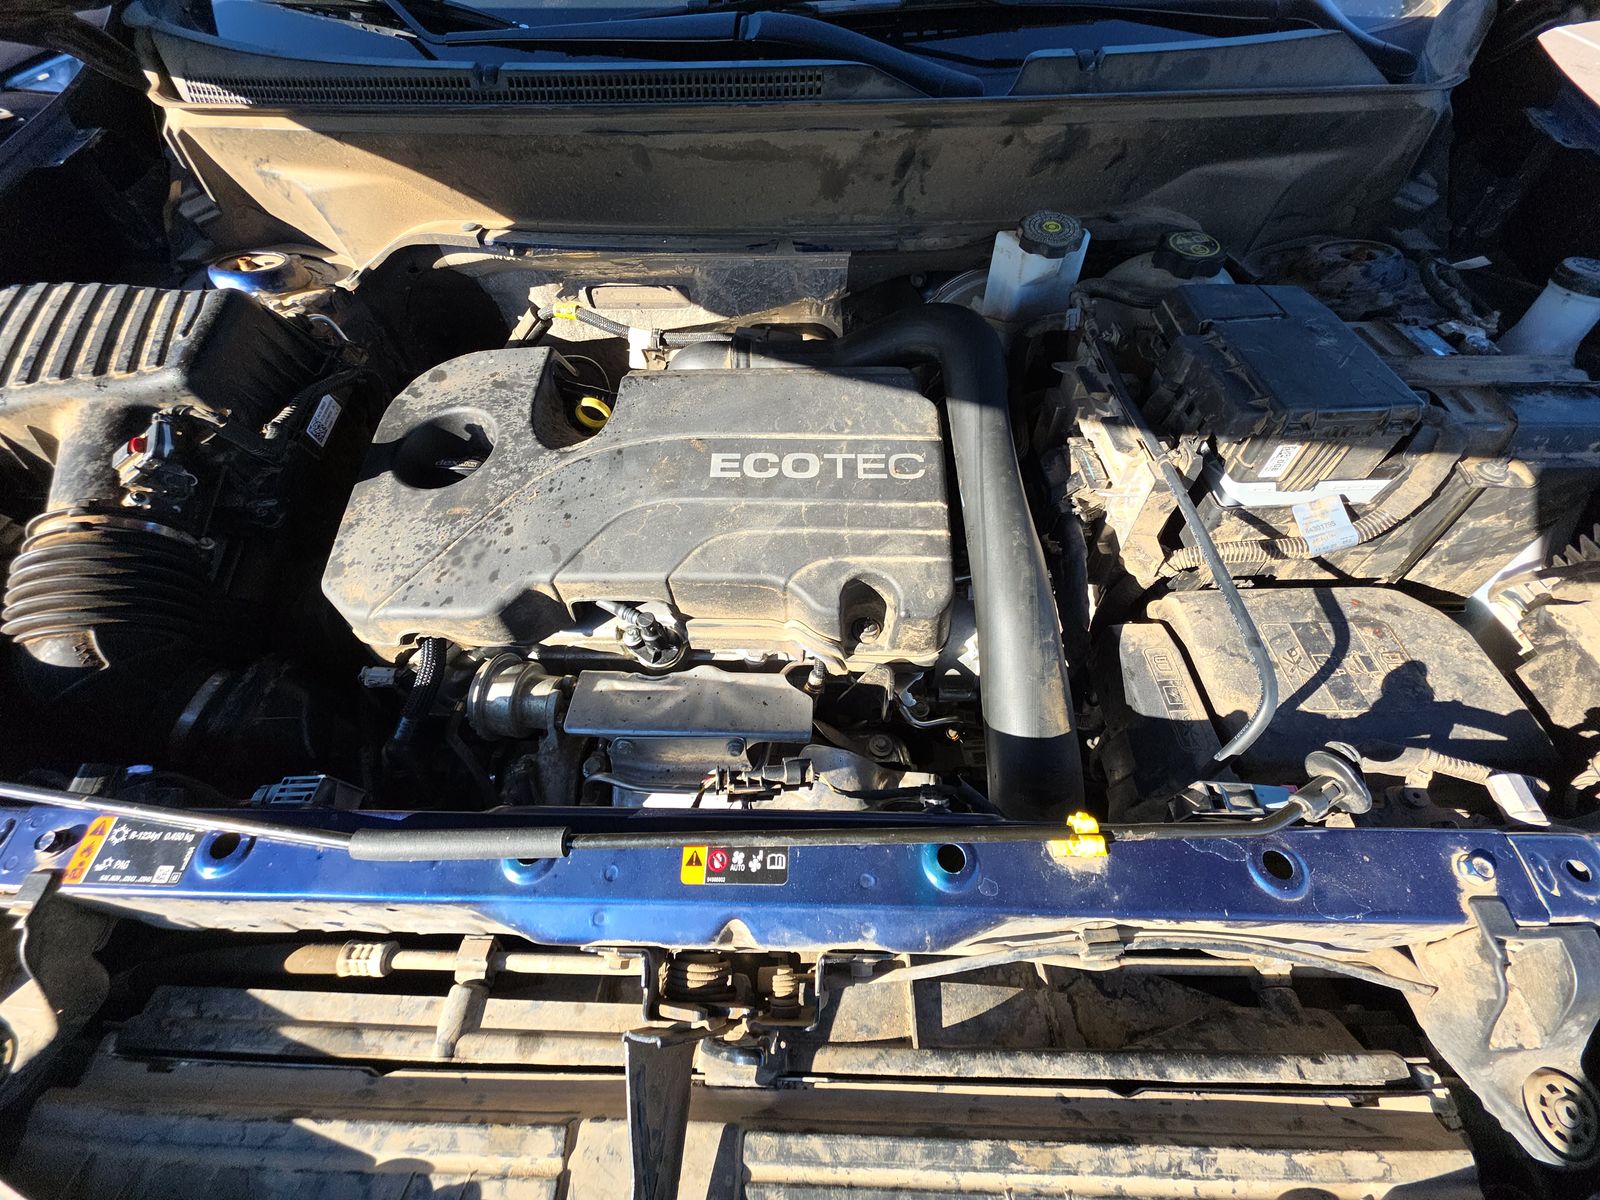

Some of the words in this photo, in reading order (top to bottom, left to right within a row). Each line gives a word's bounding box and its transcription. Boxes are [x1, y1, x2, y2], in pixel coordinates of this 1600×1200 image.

[710, 453, 926, 480] ECOTEC
[113, 860, 130, 870] PAG
[729, 864, 745, 872] AUTO
